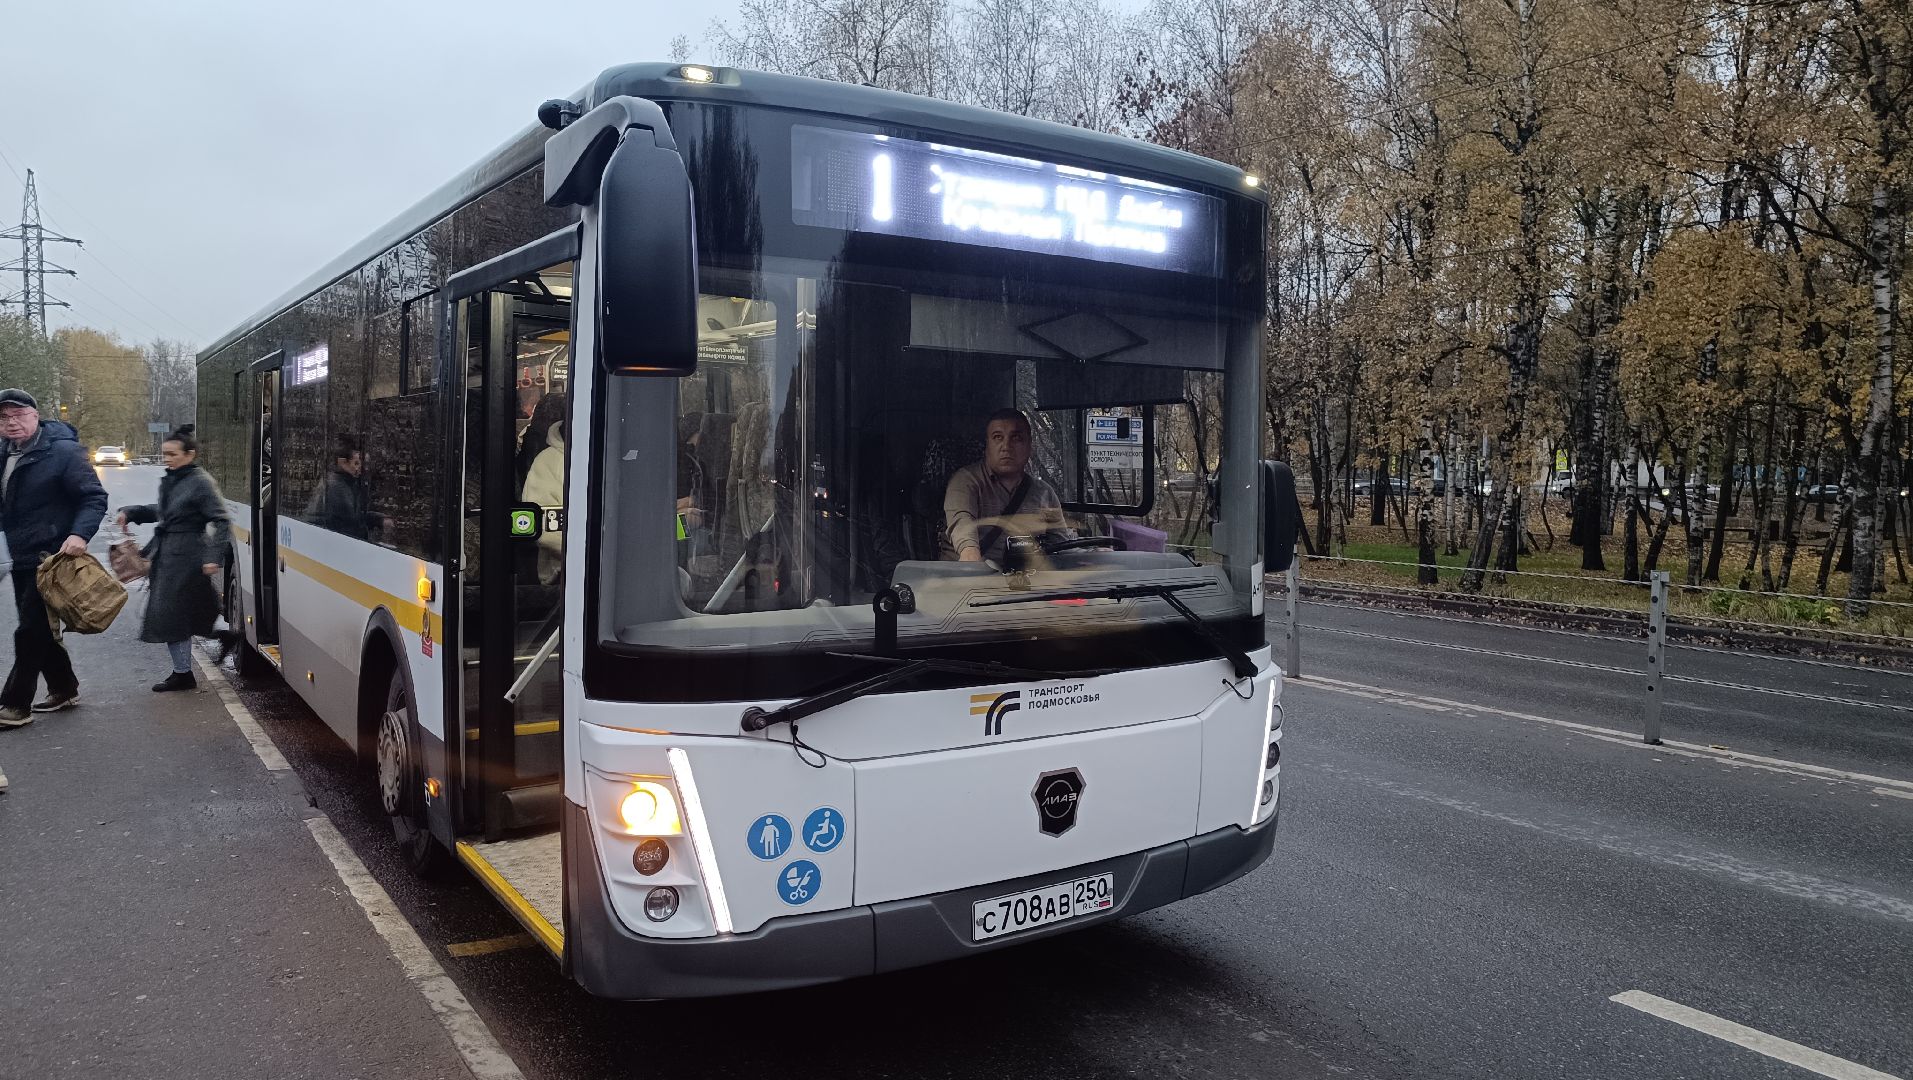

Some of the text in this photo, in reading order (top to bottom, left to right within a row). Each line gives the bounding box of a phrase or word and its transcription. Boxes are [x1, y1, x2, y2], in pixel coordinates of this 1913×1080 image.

[1028, 683, 1085, 698] ТРАНСПОРТ
[1028, 693, 1100, 710] ПОДМОСКОВЬЯ
[1075, 877, 1108, 904] 250
